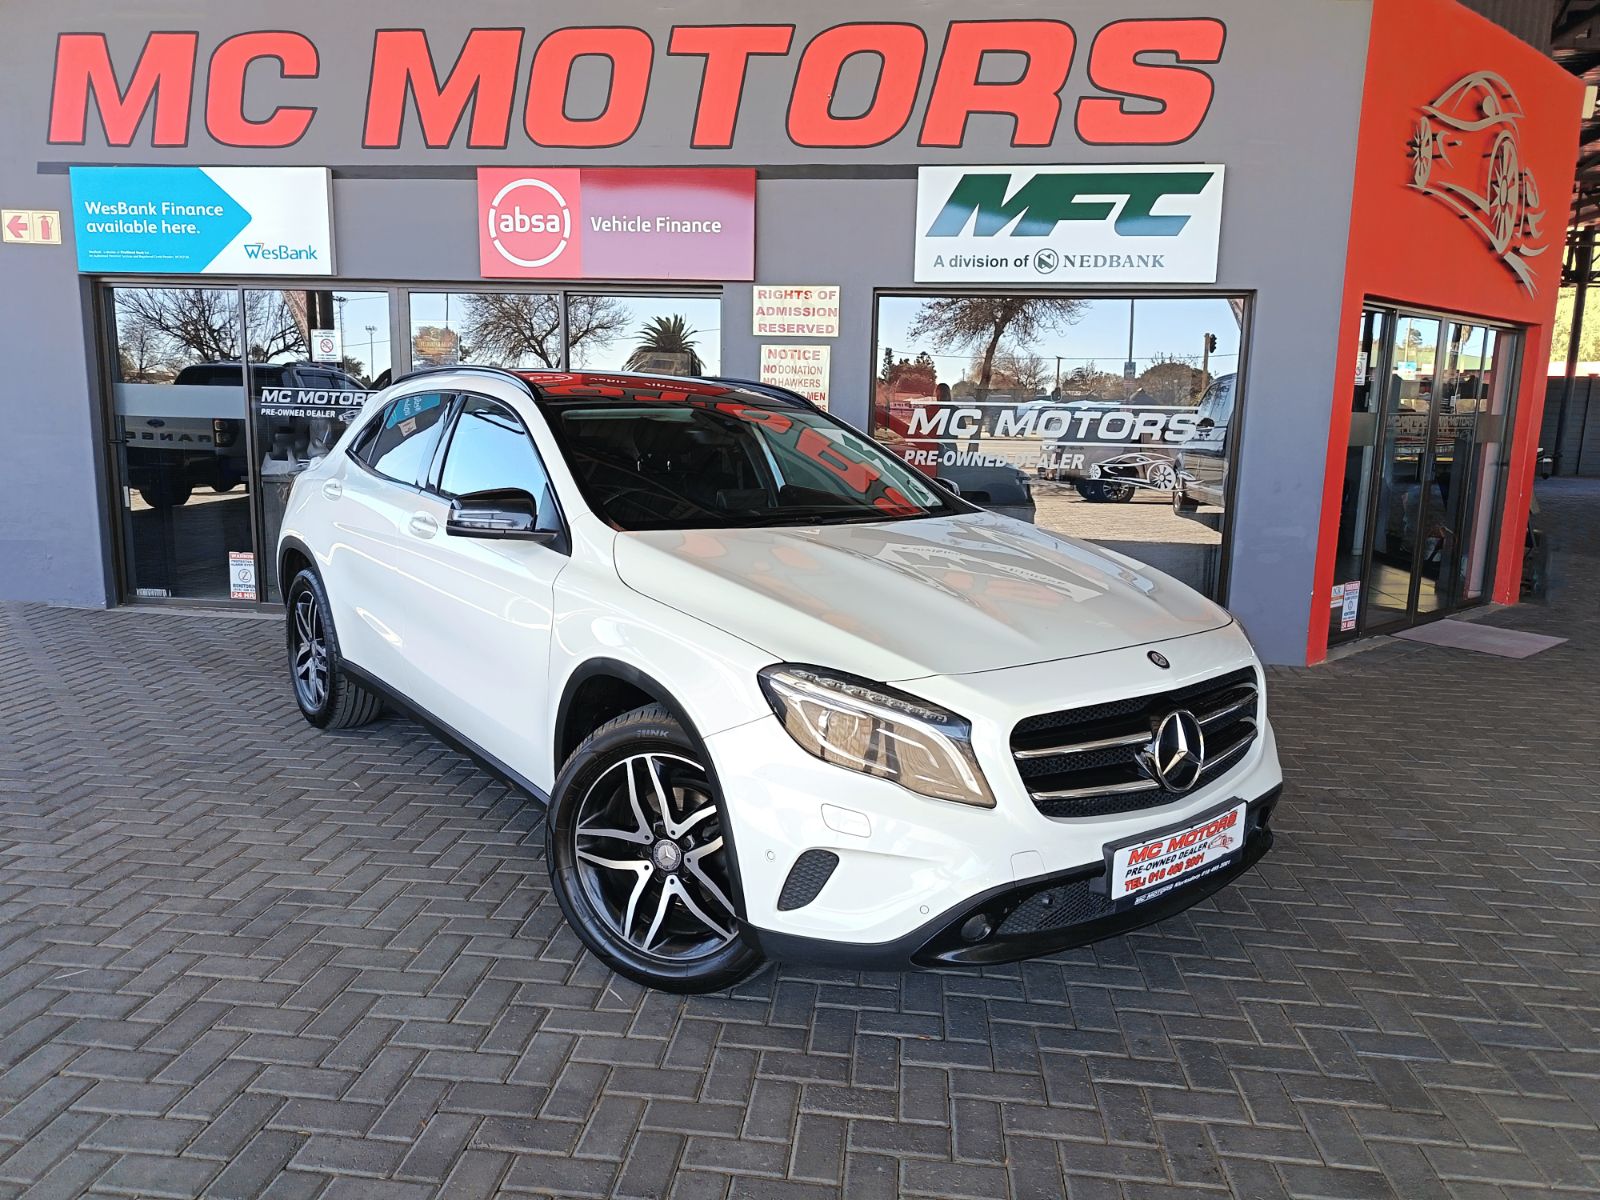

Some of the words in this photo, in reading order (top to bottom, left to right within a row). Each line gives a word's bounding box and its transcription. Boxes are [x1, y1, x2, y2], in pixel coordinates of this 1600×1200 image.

[47, 30, 320, 148] MC
[362, 18, 1226, 149] MOTORS
[85, 201, 157, 216] WesBank
[162, 201, 224, 216] Finance
[925, 172, 1214, 237] MFC
[86, 220, 158, 234] available
[162, 220, 201, 234] here.
[500, 206, 560, 233] absa
[590, 216, 651, 232] Vehicle
[656, 216, 722, 233] Finance
[244, 243, 318, 260] WesBank
[933, 256, 945, 268] A
[949, 255, 1008, 268] division
[1013, 254, 1029, 268] of
[1063, 254, 1165, 268] NEDBANK
[758, 290, 812, 300] RIGHTS
[817, 291, 837, 300] OF
[756, 306, 838, 317] ADMISSION
[758, 323, 835, 334] RESERVED
[767, 349, 821, 360] NOTICE
[763, 364, 777, 374] NO
[778, 365, 823, 375] DONATION
[778, 378, 821, 388] HAWKERS
[261, 390, 292, 403] MC
[261, 409, 305, 418] PRE-OWNED
[306, 410, 336, 418] DEALER
[907, 408, 982, 436] MC
[994, 409, 1197, 442] MOTORS
[905, 450, 1007, 468] PRE-OWNED
[1012, 452, 1085, 470] DEALER
[1128, 843, 1163, 865] MC
[1166, 809, 1238, 852] MOTORS
[1125, 854, 1176, 878] PRE-OWNED
[1178, 841, 1208, 859] DEALER
[1124, 876, 1146, 892] TEL:
